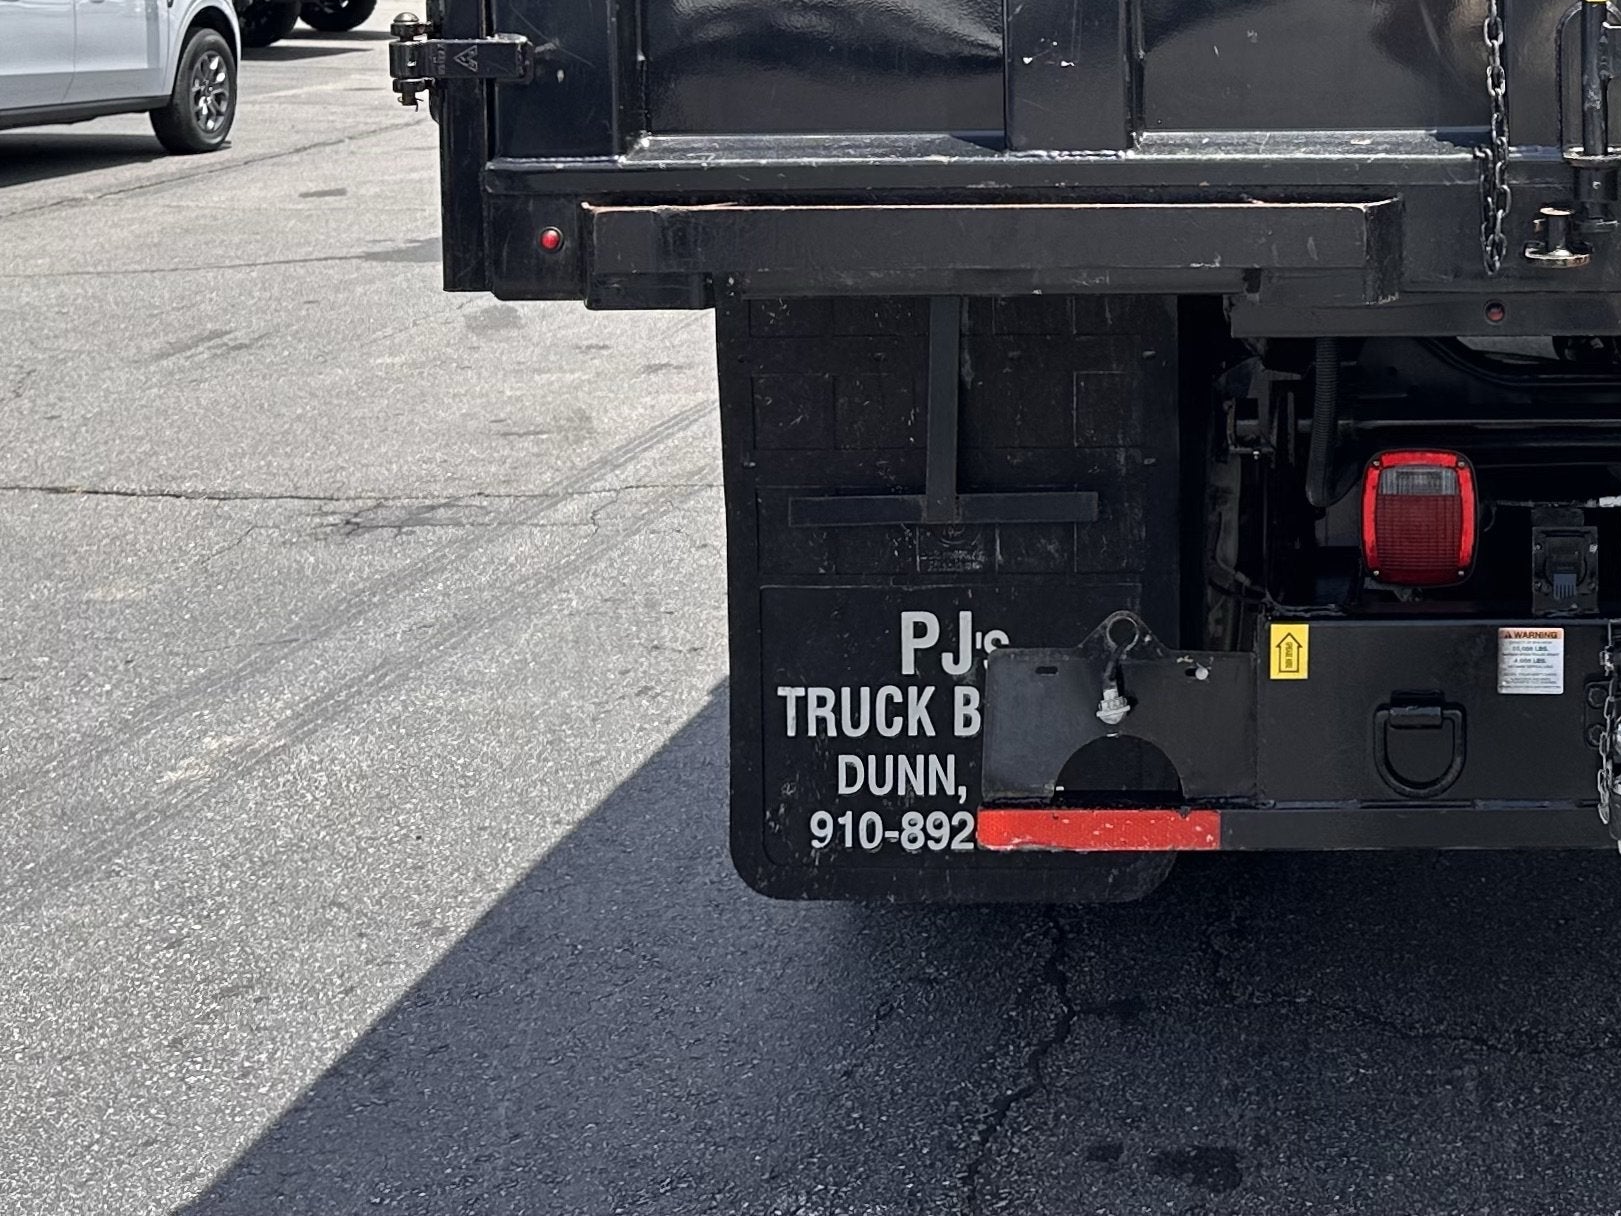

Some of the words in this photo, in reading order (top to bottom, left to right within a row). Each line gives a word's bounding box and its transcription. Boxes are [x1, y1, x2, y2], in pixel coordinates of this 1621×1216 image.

[1514, 631, 1558, 639] WARNING
[777, 685, 936, 738] TRUCK
[837, 753, 967, 804] DUNN,
